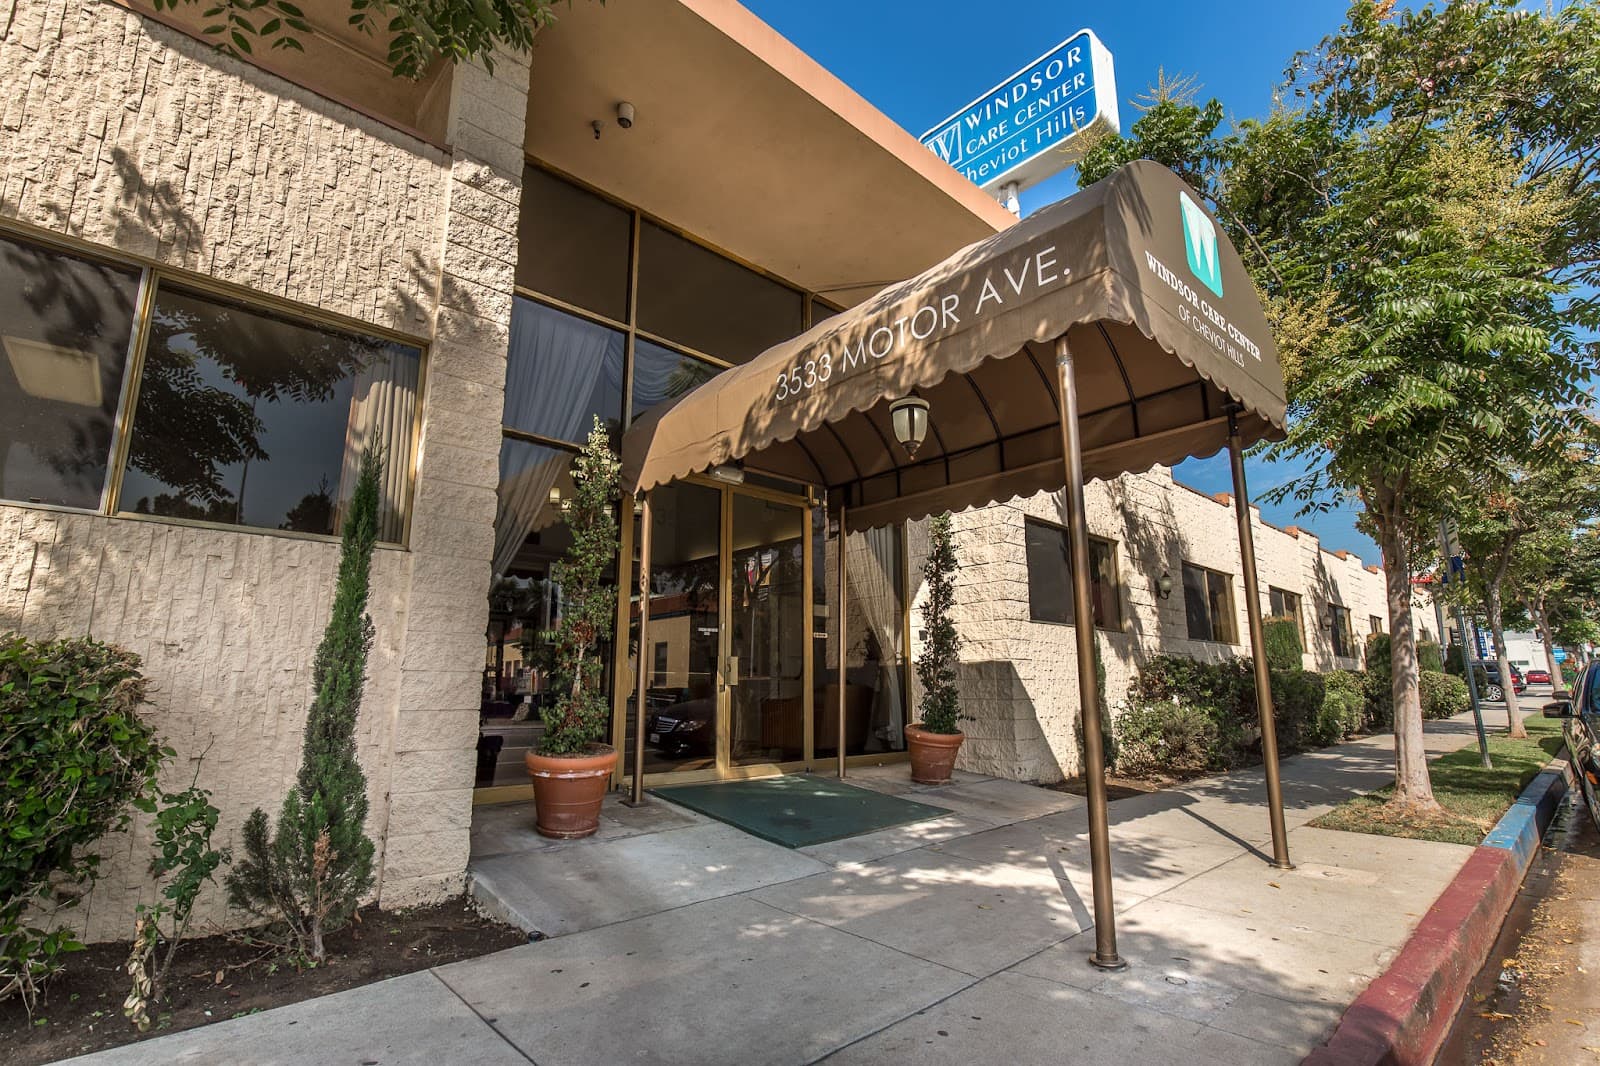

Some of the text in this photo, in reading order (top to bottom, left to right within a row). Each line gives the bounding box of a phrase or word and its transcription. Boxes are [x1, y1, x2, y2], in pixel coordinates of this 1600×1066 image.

[964, 46, 1082, 130] WINDSOR
[966, 72, 1086, 155] CARE CENTER
[1036, 105, 1086, 144] Hills
[775, 246, 1070, 401] 3533 MOTOR AVE.
[1145, 250, 1262, 362] WINDSOR CARE CENTER
[1178, 304, 1245, 368] OF CHEVIOT HILLS
